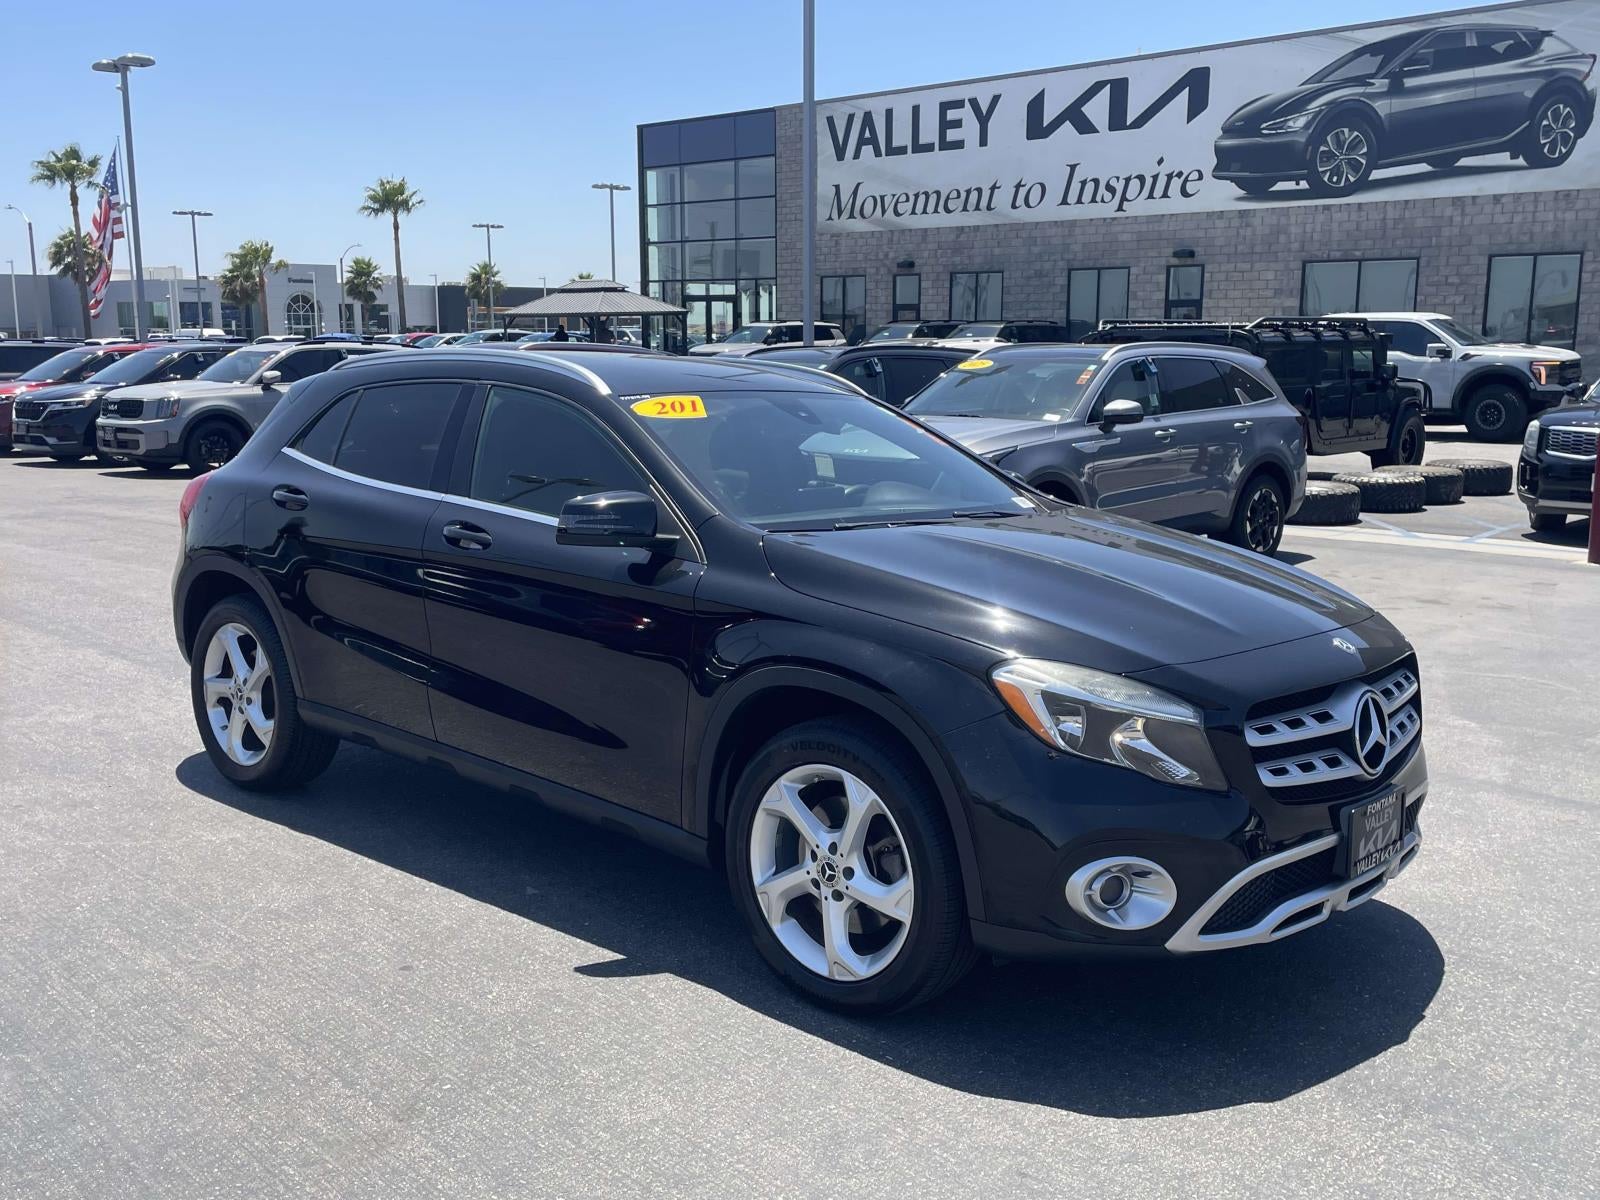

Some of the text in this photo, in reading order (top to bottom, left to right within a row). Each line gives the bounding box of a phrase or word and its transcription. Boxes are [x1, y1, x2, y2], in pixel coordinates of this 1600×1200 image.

[826, 66, 1211, 162] VALLEY KIA
[825, 155, 1205, 222] Movement to Inspire
[1367, 793, 1397, 816] FONTANA
[1365, 806, 1394, 832] VALLEY
[1356, 851, 1382, 875] VALLEY
